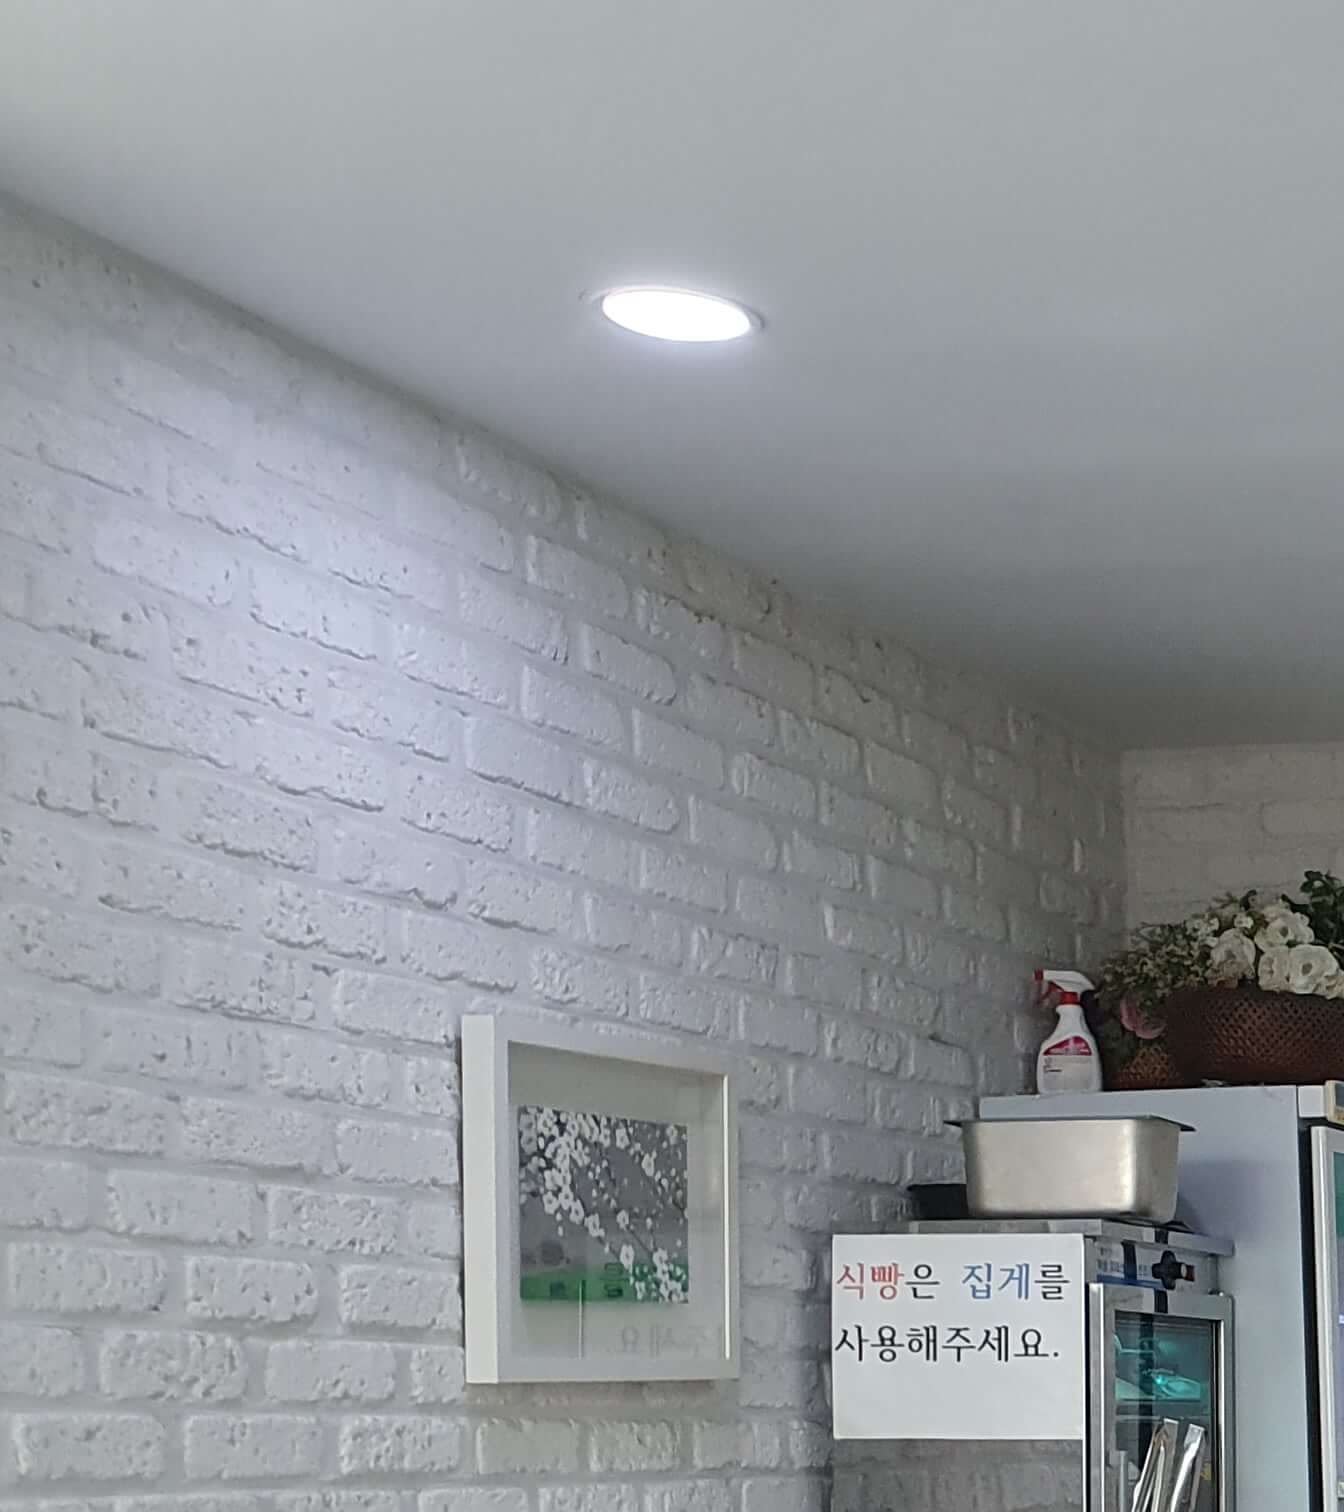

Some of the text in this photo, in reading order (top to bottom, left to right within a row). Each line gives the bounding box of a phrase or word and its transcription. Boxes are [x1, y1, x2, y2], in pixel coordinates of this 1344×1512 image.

[836, 1262, 1071, 1301] 식빵은 집게를
[834, 1324, 1060, 1363] 사용해주세요.
